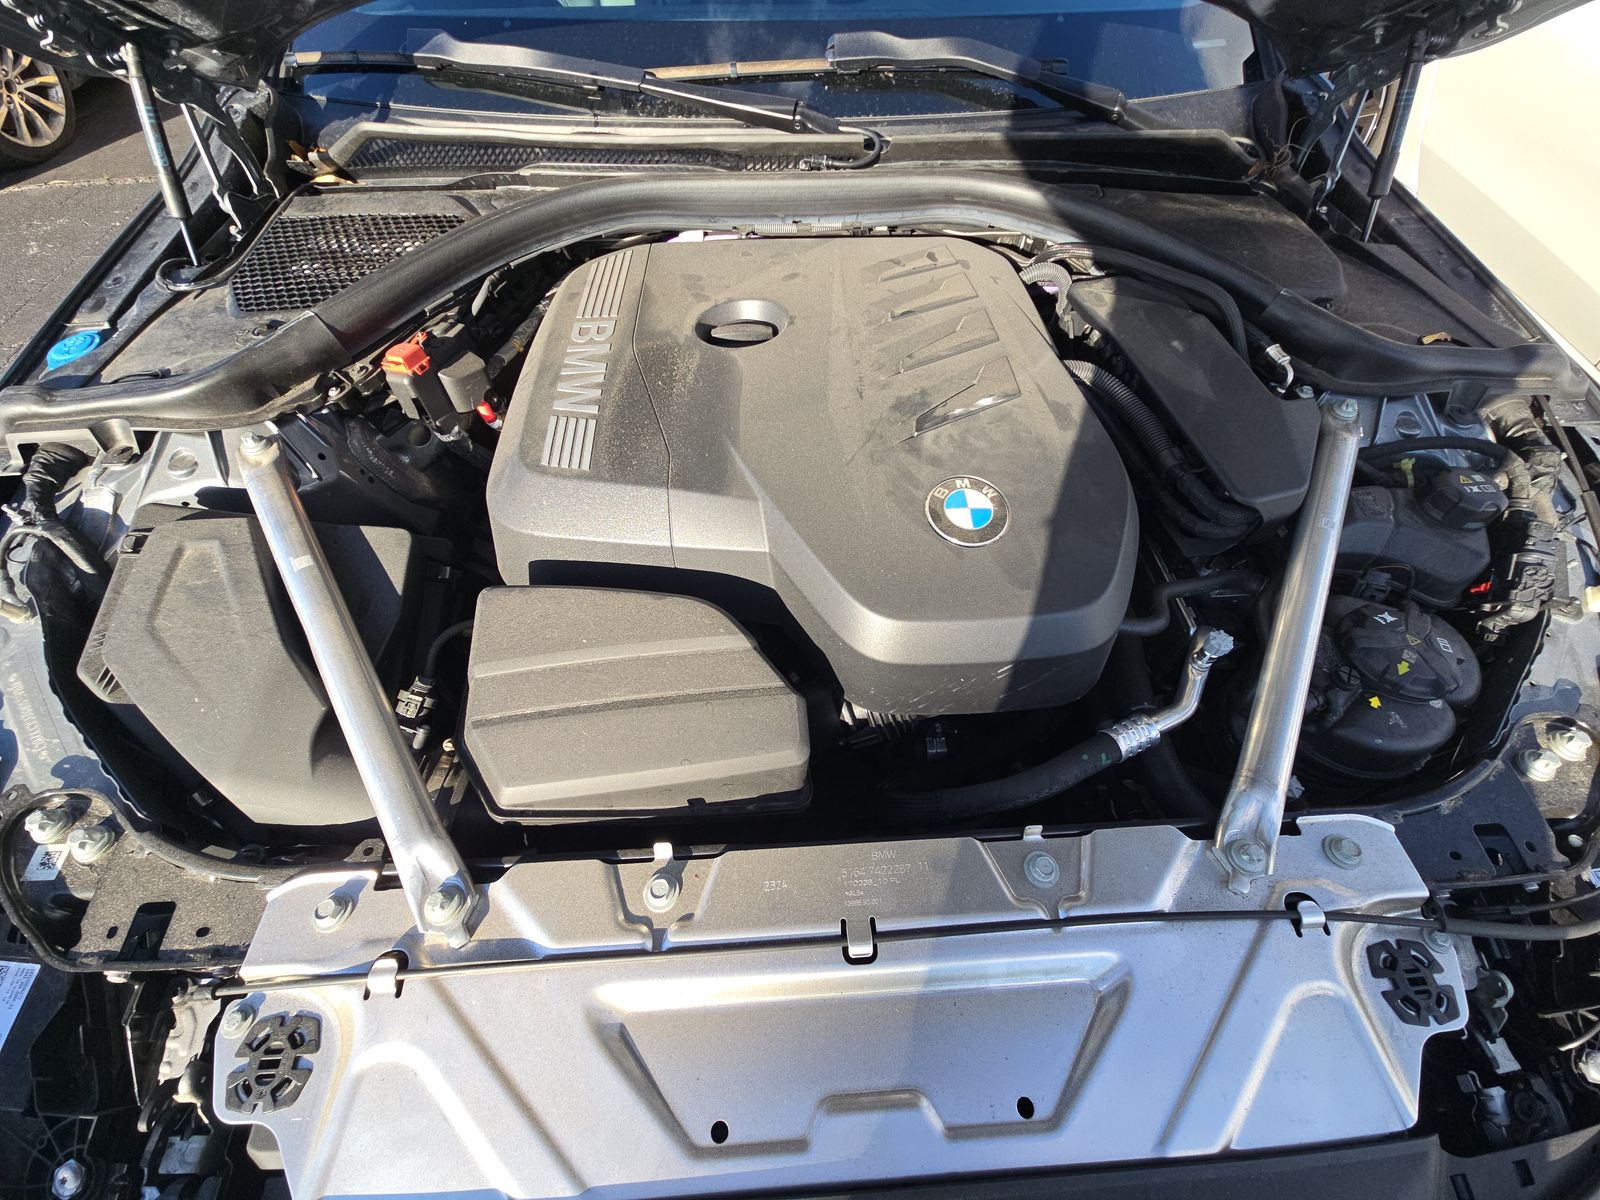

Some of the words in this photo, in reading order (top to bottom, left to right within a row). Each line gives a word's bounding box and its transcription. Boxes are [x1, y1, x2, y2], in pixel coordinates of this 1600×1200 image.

[552, 319, 617, 414] BMW
[933, 478, 998, 500] BMW
[871, 850, 897, 860] BMW
